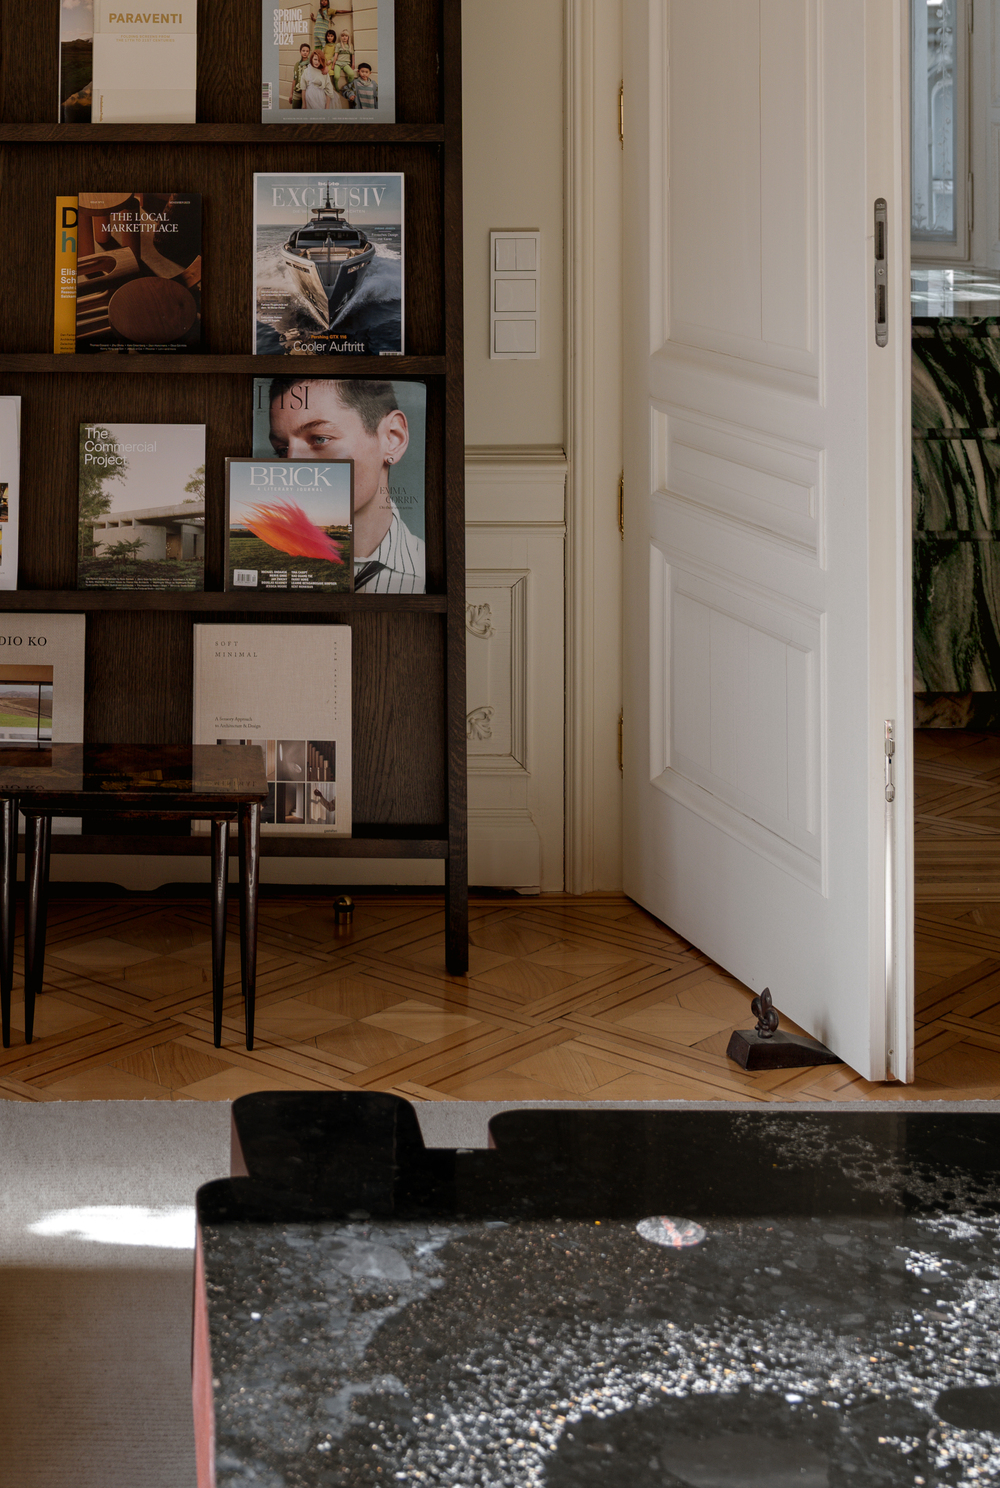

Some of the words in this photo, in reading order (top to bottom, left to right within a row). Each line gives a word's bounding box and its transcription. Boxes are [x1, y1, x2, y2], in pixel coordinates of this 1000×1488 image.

[109, 13, 182, 24] PARAVENTI
[274, 9, 302, 21] SPRING
[274, 21, 308, 33] SUMMER
[274, 33, 294, 45] 2024
[271, 187, 386, 207] EXCLUSIV
[110, 213, 132, 221] THE
[135, 213, 170, 221] LOCAL
[101, 224, 178, 232] MARKETPLACE
[62, 231, 76, 252] h
[293, 341, 326, 352] Cooler
[329, 341, 365, 352] Auftritt
[84, 427, 108, 439] The
[84, 441, 157, 453] Commercial
[84, 454, 127, 467] Project
[250, 466, 332, 486] BRICK
[28, 636, 48, 647] KO
